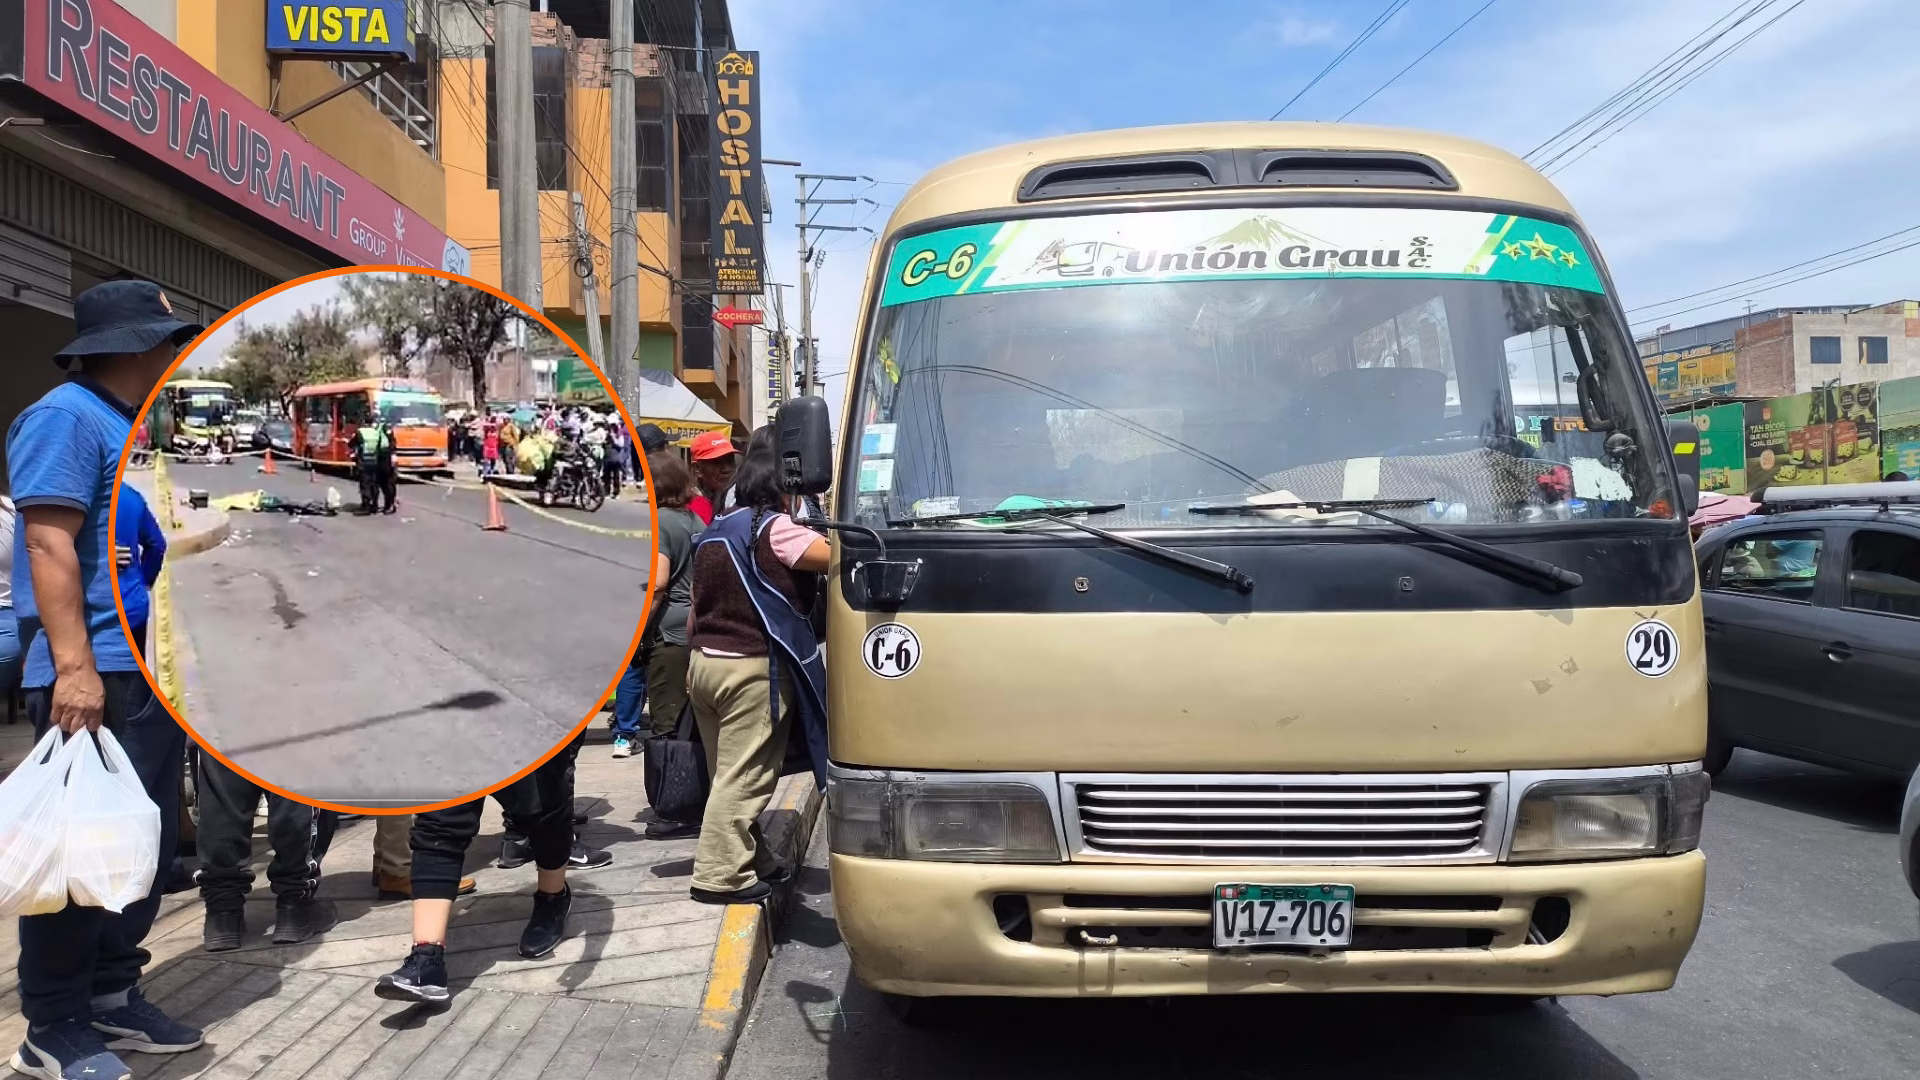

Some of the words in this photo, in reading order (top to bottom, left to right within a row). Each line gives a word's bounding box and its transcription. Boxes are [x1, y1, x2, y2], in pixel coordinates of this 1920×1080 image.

[283, 5, 390, 43] VISTA
[47, 0, 346, 239] RESTAURANT
[716, 78, 754, 256] HOSTAL
[349, 217, 387, 258] GROUP
[901, 242, 977, 287] C-6
[1124, 244, 1268, 273] Unión
[1277, 244, 1401, 268] Grau
[716, 312, 760, 320] COCHERA
[894, 628, 910, 639] GRAU
[1634, 629, 1671, 668] 29
[872, 637, 911, 671] C-6
[1220, 900, 1346, 938] V1Z-706
